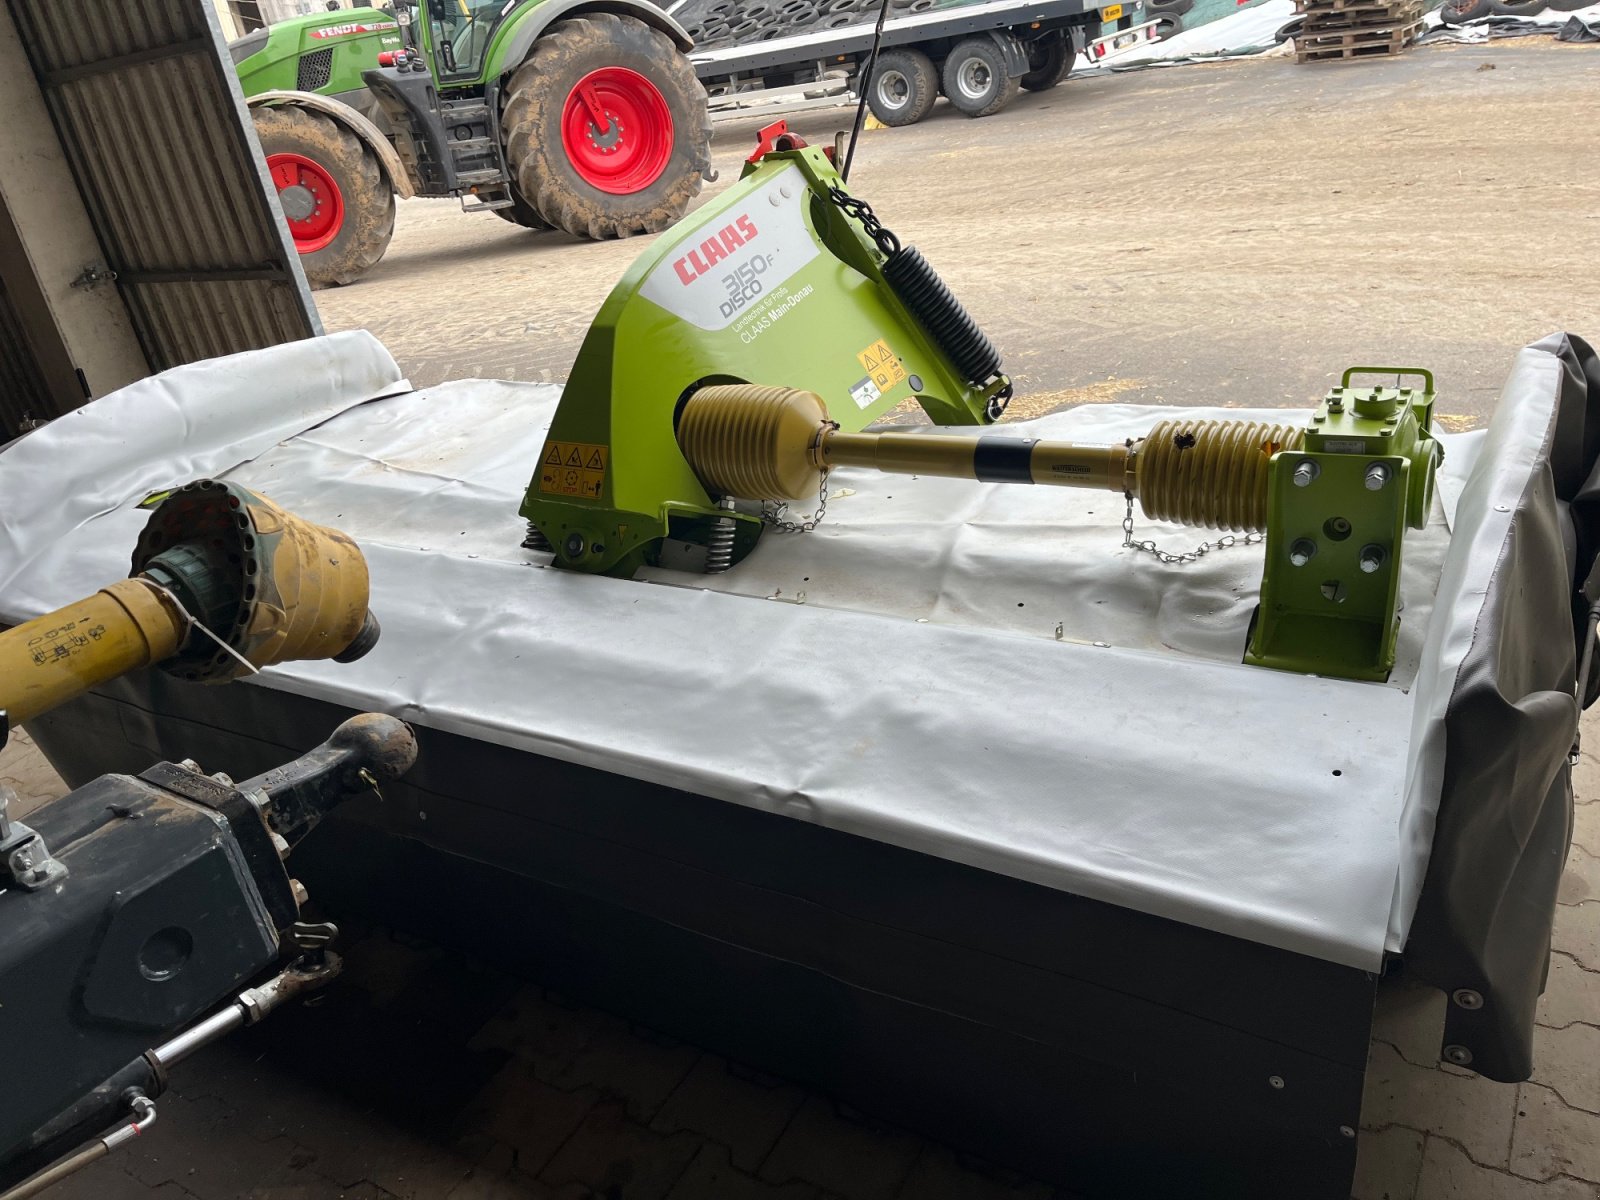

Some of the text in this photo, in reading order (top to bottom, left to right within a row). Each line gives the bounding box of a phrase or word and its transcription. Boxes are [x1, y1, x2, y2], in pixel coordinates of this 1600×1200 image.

[318, 23, 359, 38] FENDT
[673, 213, 758, 286] CLAAS
[719, 279, 763, 319] DISCO
[731, 286, 789, 333] Landtechnik für Profis
[740, 283, 814, 344] CLAAS Main-Donau
